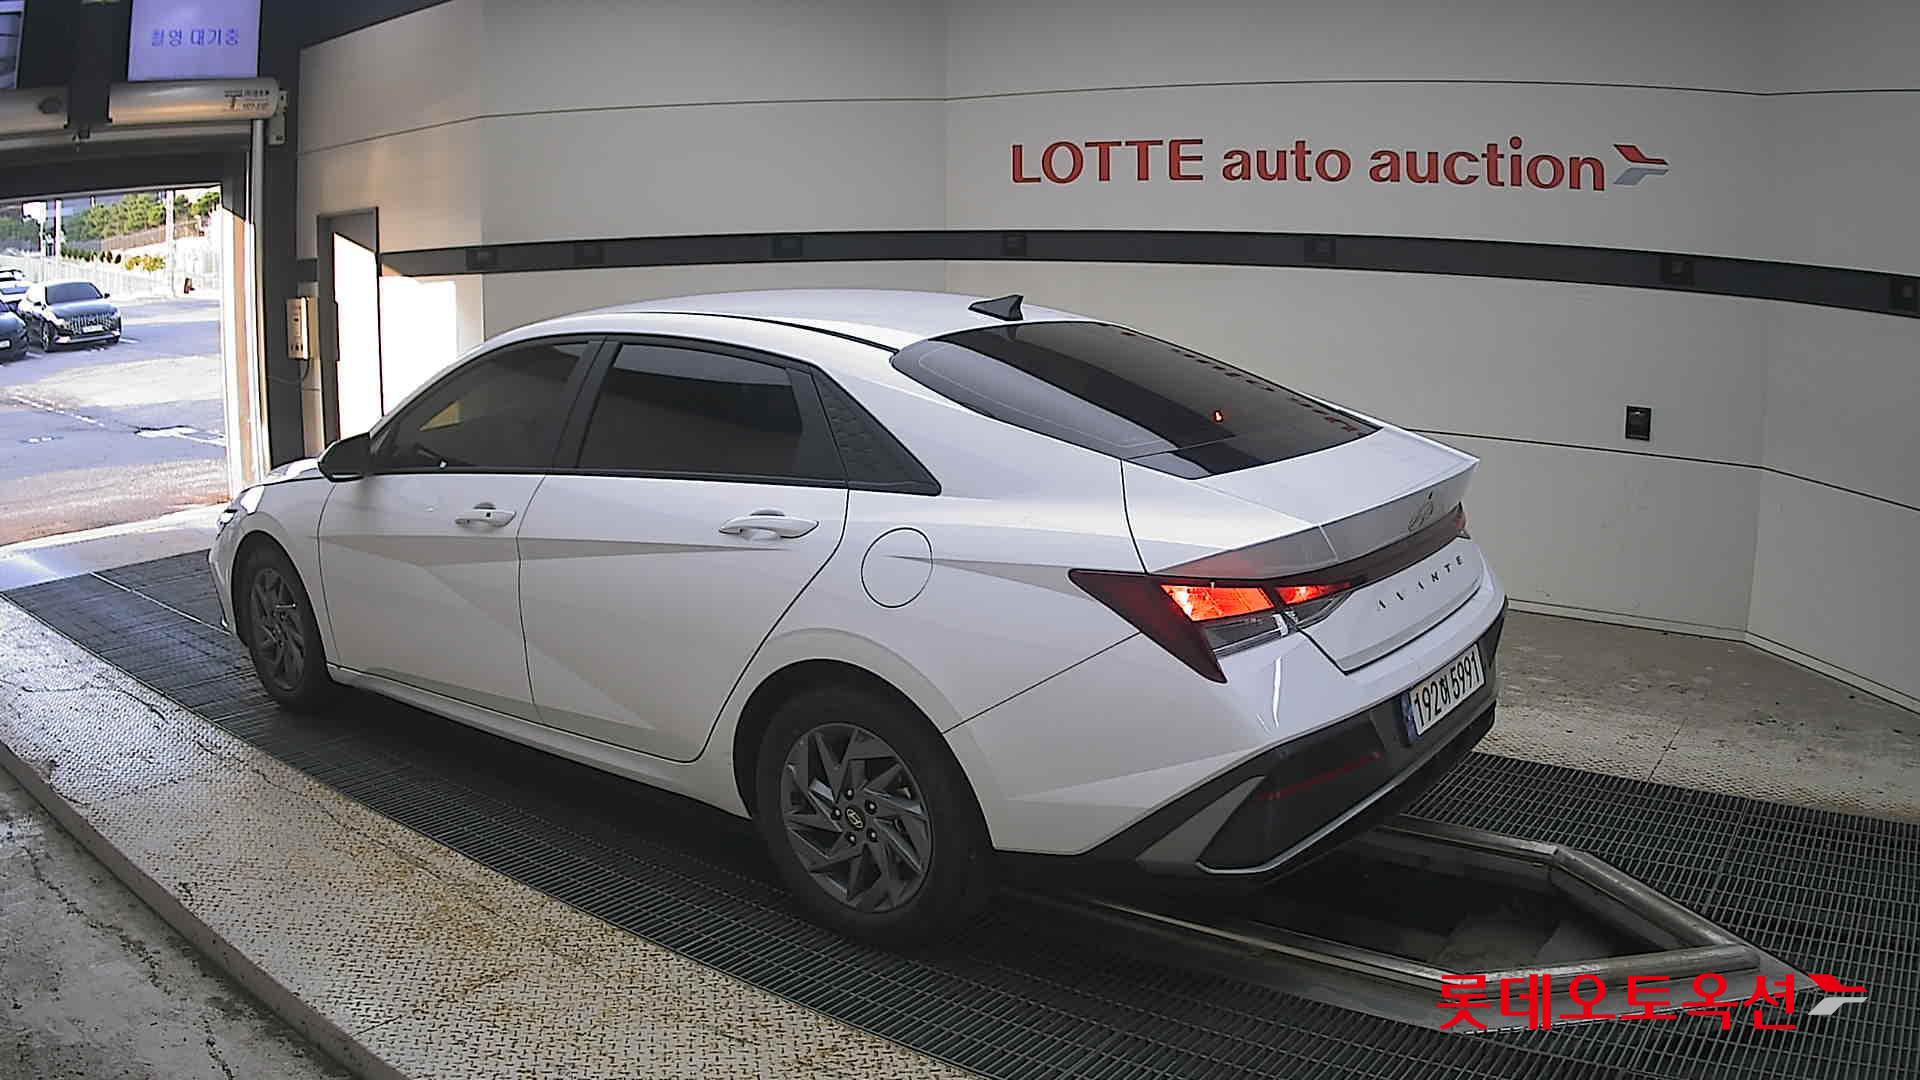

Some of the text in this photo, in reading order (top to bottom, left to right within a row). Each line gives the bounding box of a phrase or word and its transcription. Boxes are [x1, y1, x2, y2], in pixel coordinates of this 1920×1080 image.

[1011, 136, 1606, 190] LOTTE auto auction
